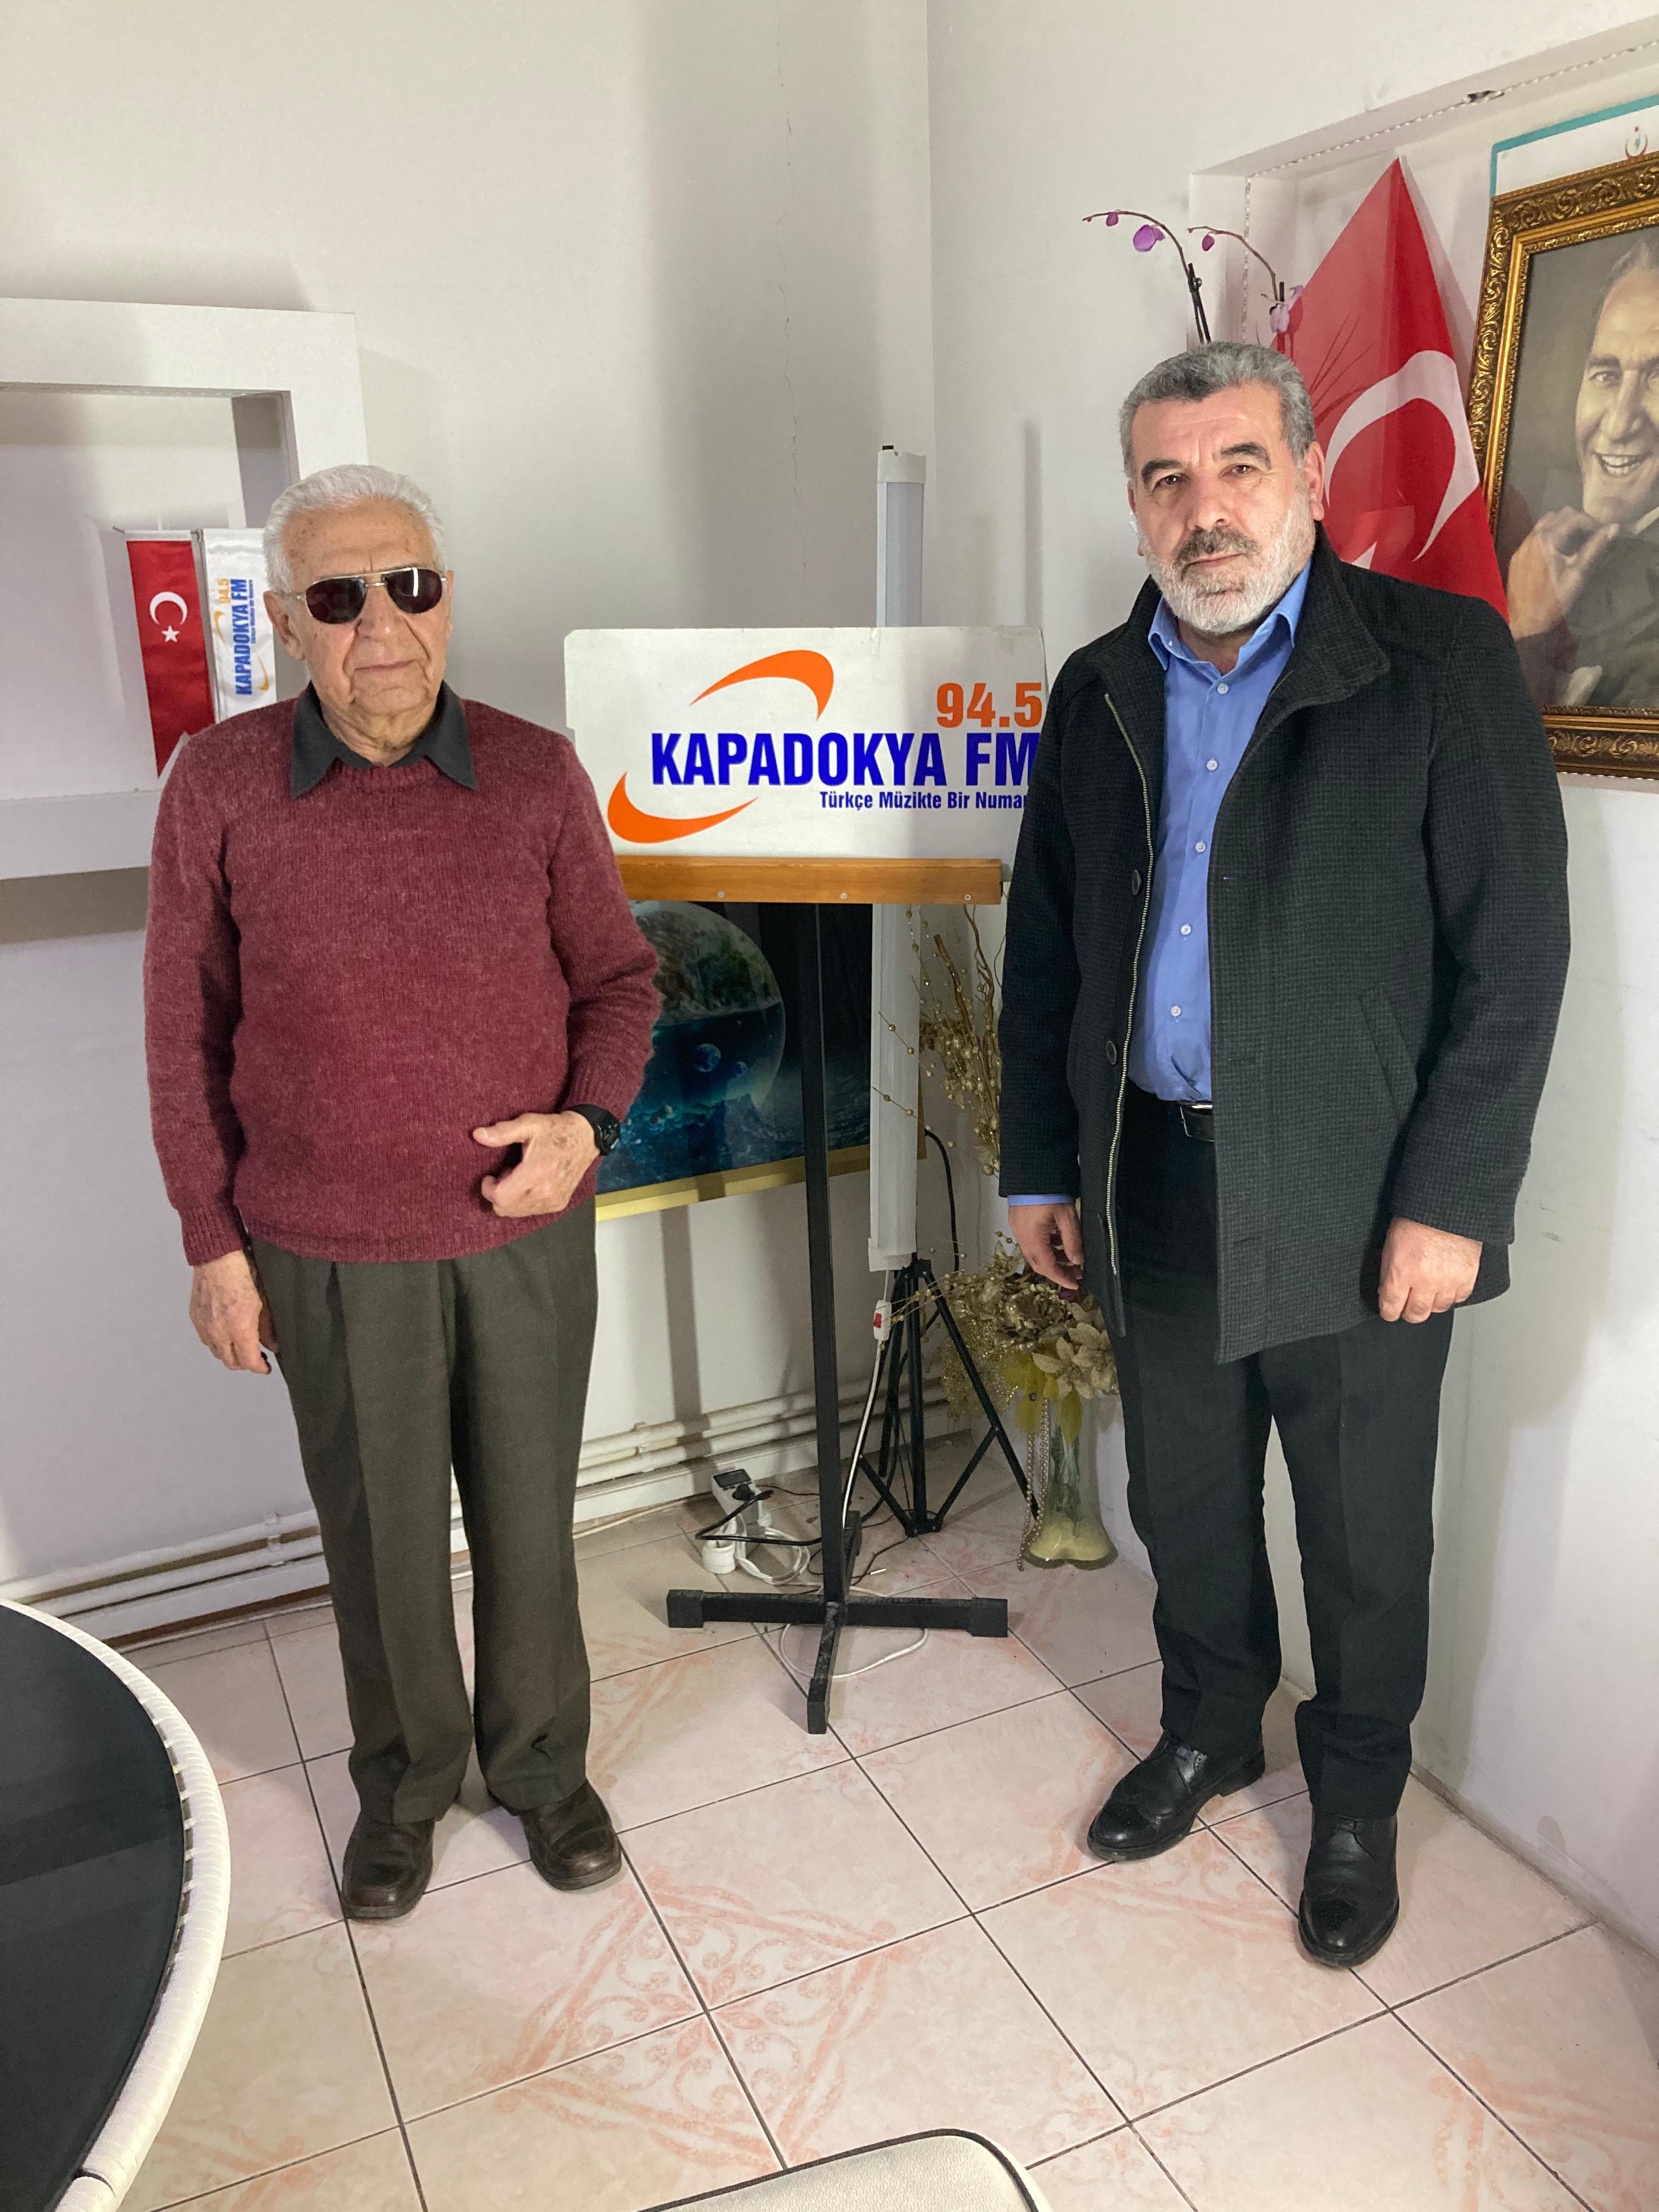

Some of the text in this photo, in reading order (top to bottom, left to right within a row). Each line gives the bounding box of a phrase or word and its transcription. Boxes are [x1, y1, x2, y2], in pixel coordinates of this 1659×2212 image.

[218, 578, 231, 603] 94.5
[231, 579, 252, 695] KAPADOKYA FM
[936, 682, 1043, 729] 94.5
[651, 732, 1041, 787] KAPADOKYA FM
[820, 791, 873, 811] Türkçe
[878, 791, 942, 810] Müzikte
[947, 791, 970, 809] Bir
